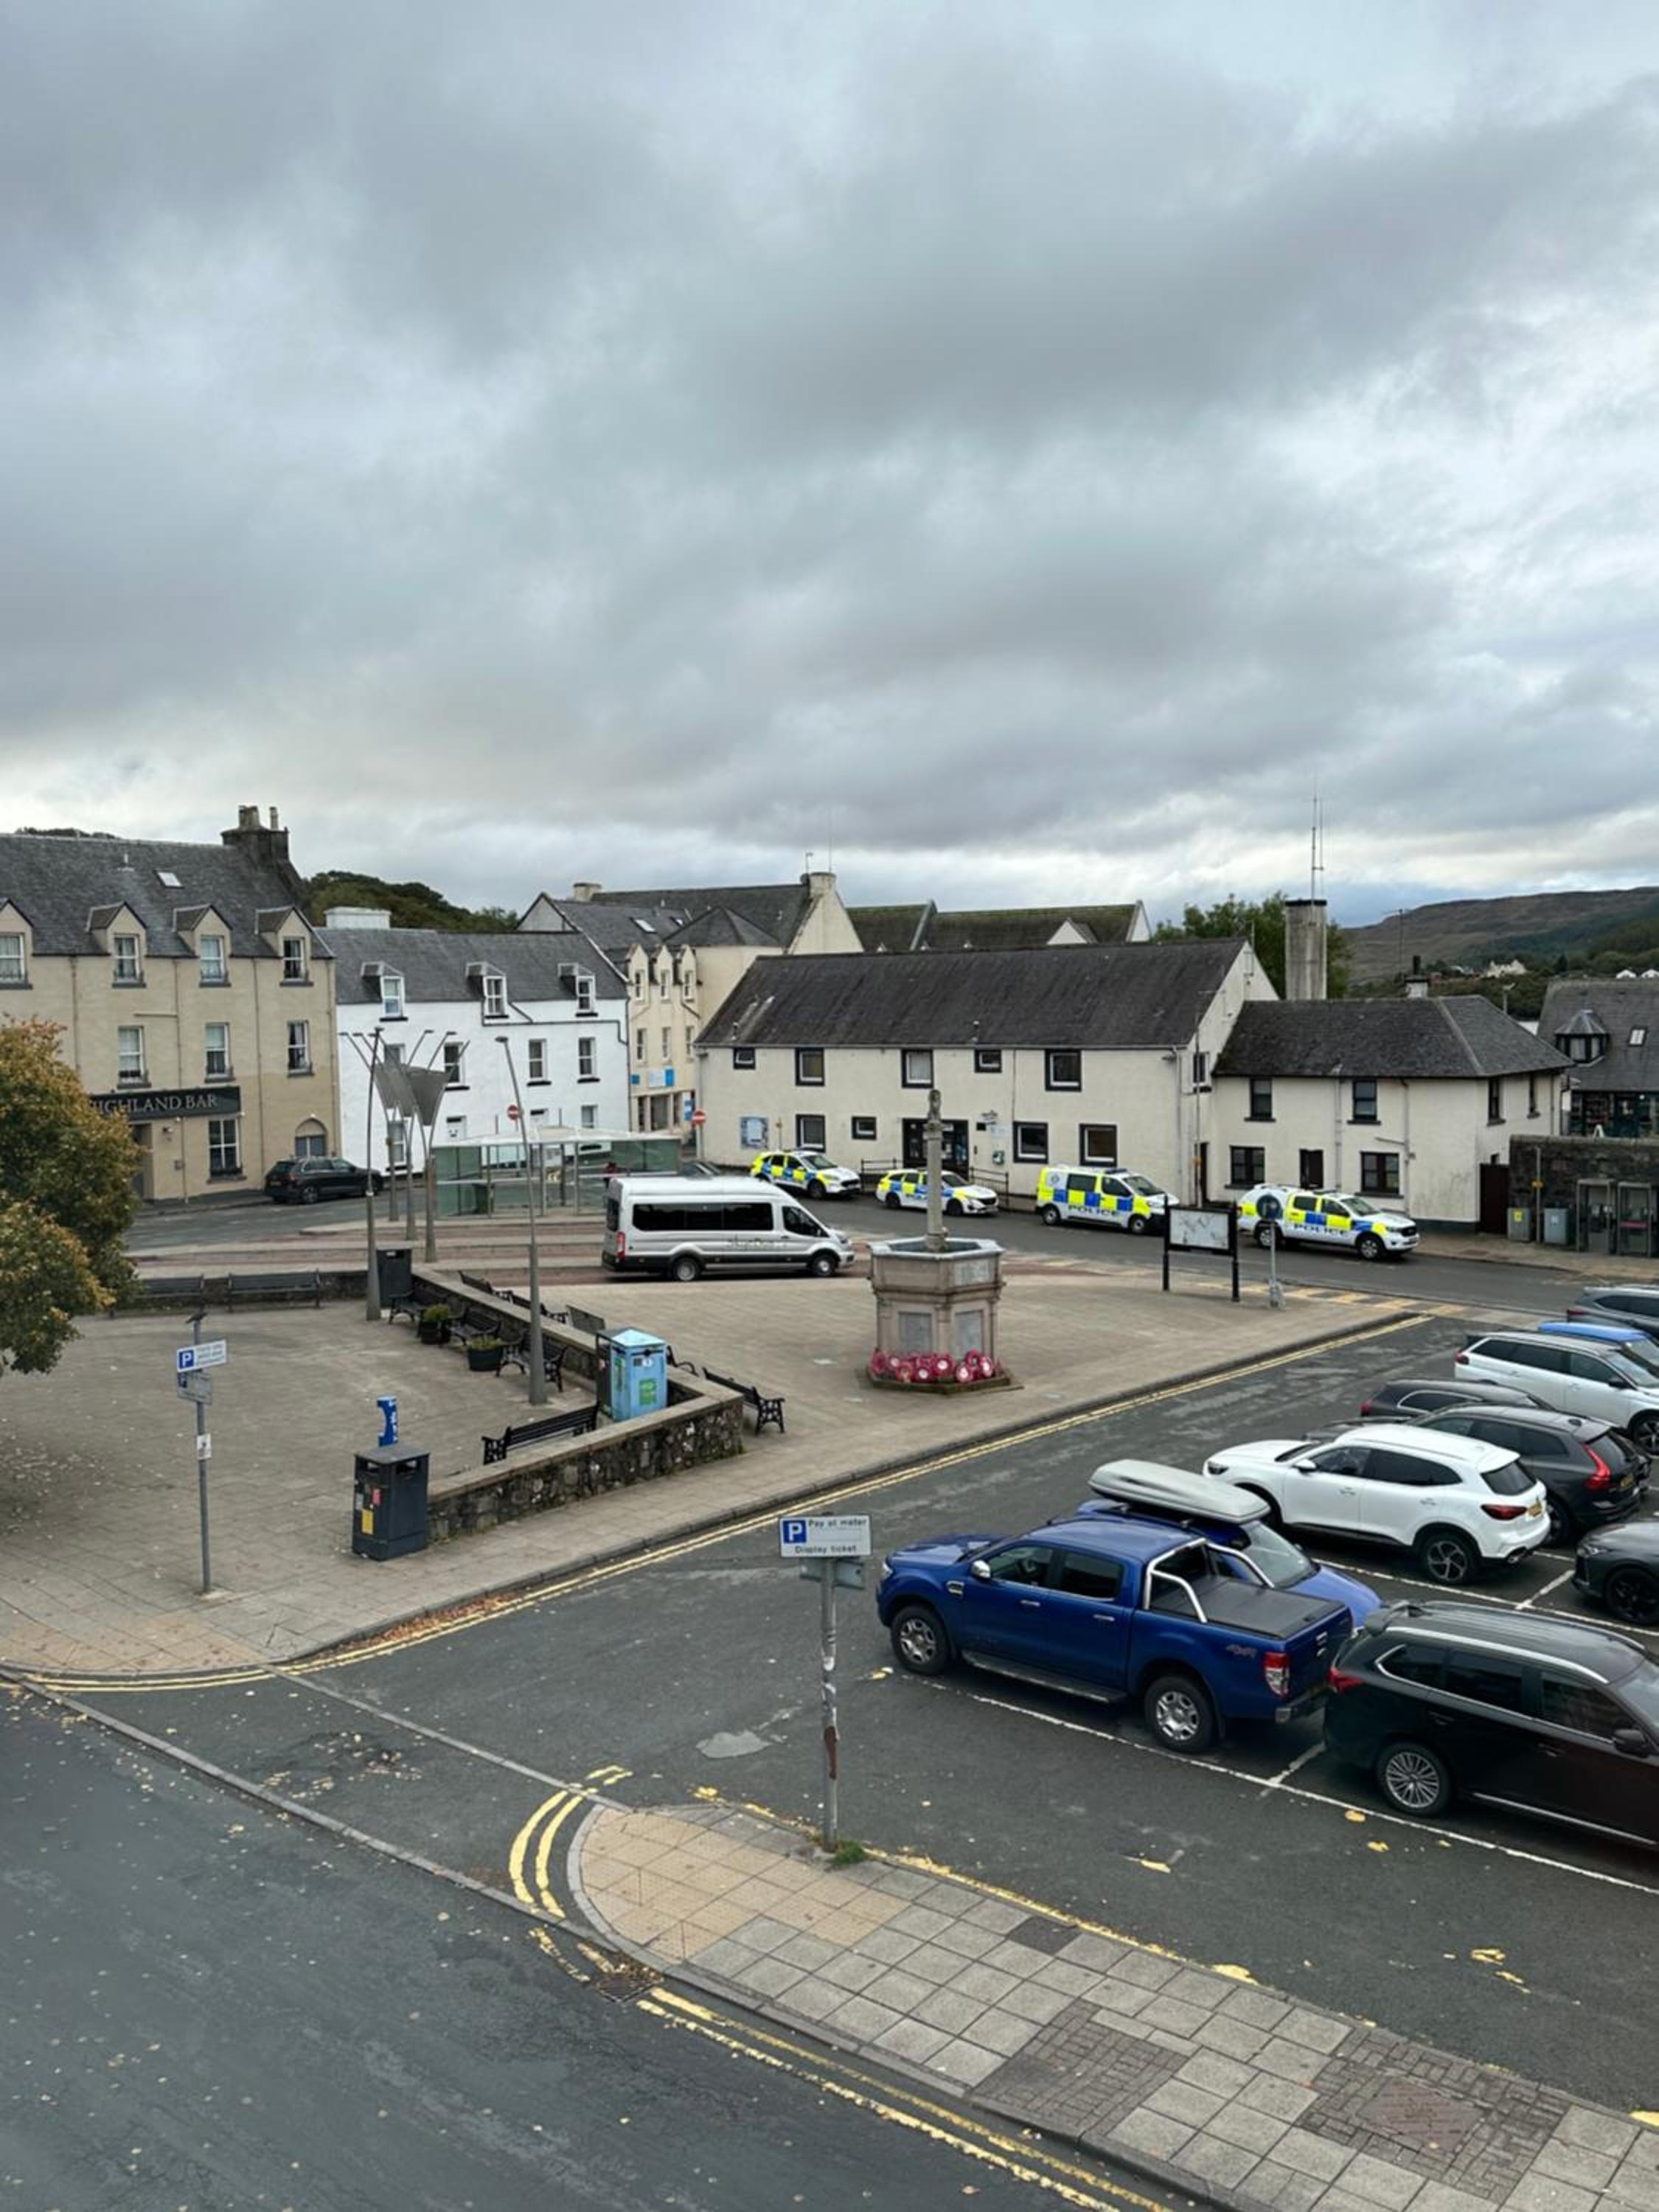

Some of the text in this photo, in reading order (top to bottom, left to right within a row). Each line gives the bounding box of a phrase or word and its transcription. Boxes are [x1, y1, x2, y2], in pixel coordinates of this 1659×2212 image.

[186, 1093, 218, 1107] BAR
[1068, 1203, 1120, 1217] POLICE
[1293, 1223, 1348, 1237] POLICE
[182, 1352, 192, 1368] P
[808, 1519, 824, 1528] Pay
[788, 1523, 803, 1543] P
[794, 1545, 827, 1554] Display
